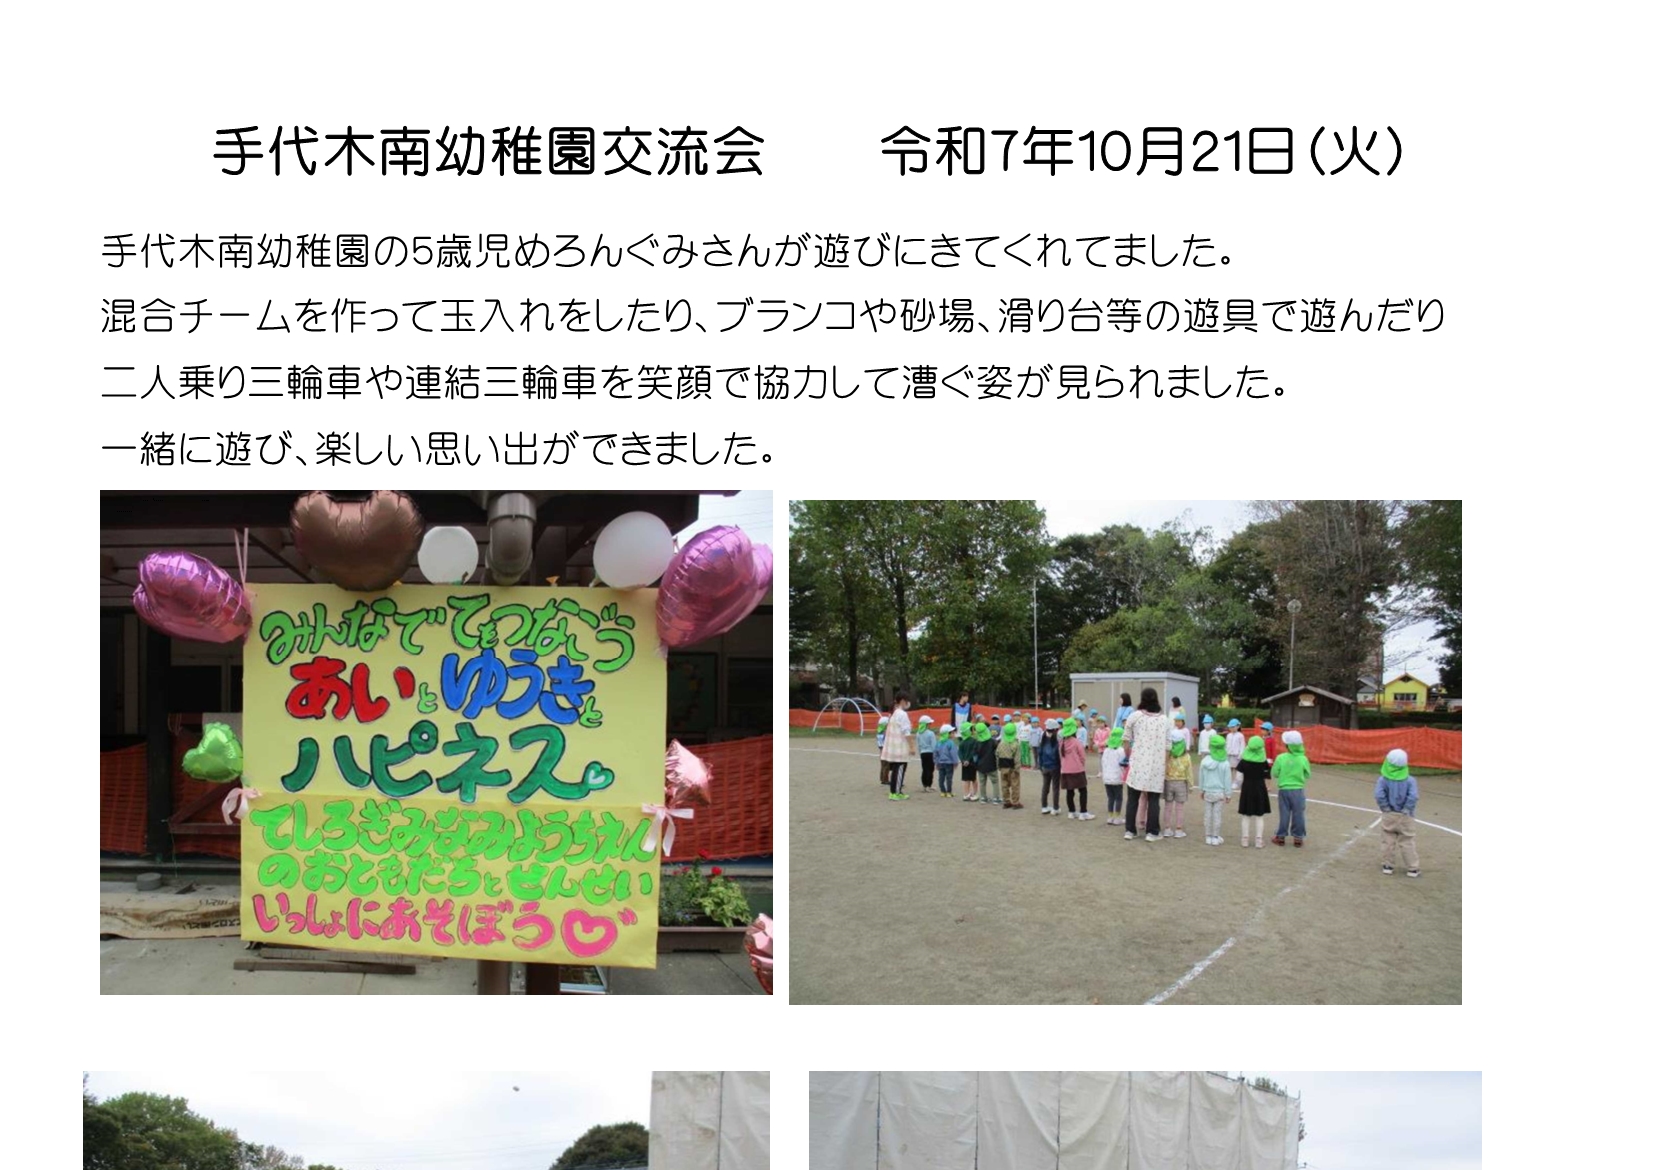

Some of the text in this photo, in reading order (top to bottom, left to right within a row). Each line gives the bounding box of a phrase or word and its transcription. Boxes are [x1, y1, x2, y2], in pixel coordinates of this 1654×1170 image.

[213, 126, 764, 176] 手代木南幼稚園交流会
[102, 232, 1230, 268] 手代木南幼稚園の5歳児めろんぐみさんが遊びにきてくれてました。
[102, 297, 1443, 333] 混合チームを作って玉入れをしたり、ブランコや砂場、滑り台等の遊具で遊んだり
[102, 364, 1283, 400] 二人乗り三輪車や連結三輪車を笑顔で協力して漕ぐ姿が見られました。
[102, 430, 771, 466] 一緒に遊び、楽しい思い出ができました。
[281, 720, 600, 804] ハピネス
[250, 798, 658, 864] てしろぎみなみようちえん
[257, 847, 653, 905] のおともだちとせんせい
